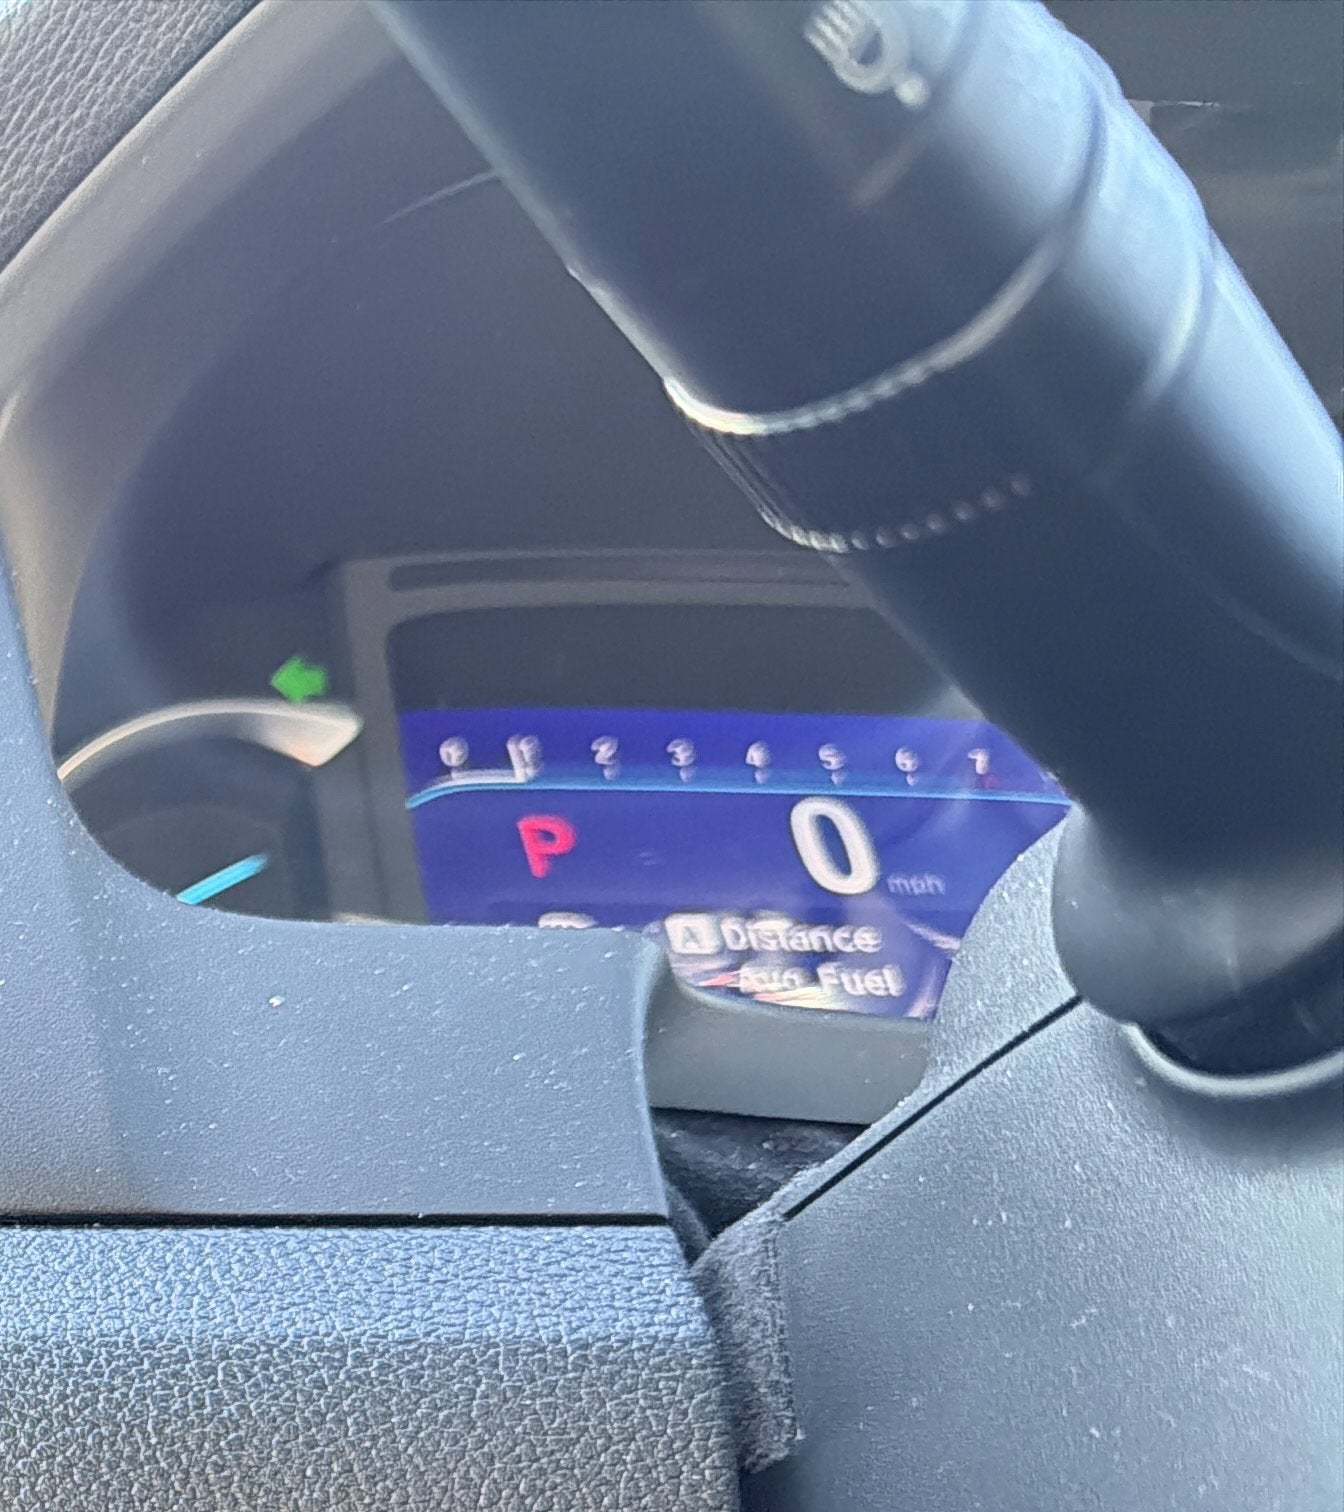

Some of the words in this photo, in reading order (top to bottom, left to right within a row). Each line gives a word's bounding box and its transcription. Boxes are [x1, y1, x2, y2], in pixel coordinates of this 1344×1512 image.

[516, 815, 576, 879] P
[790, 795, 880, 895] 0
[886, 872, 946, 897] mph
[720, 914, 883, 953] Distance
[816, 961, 907, 998] Fuel
